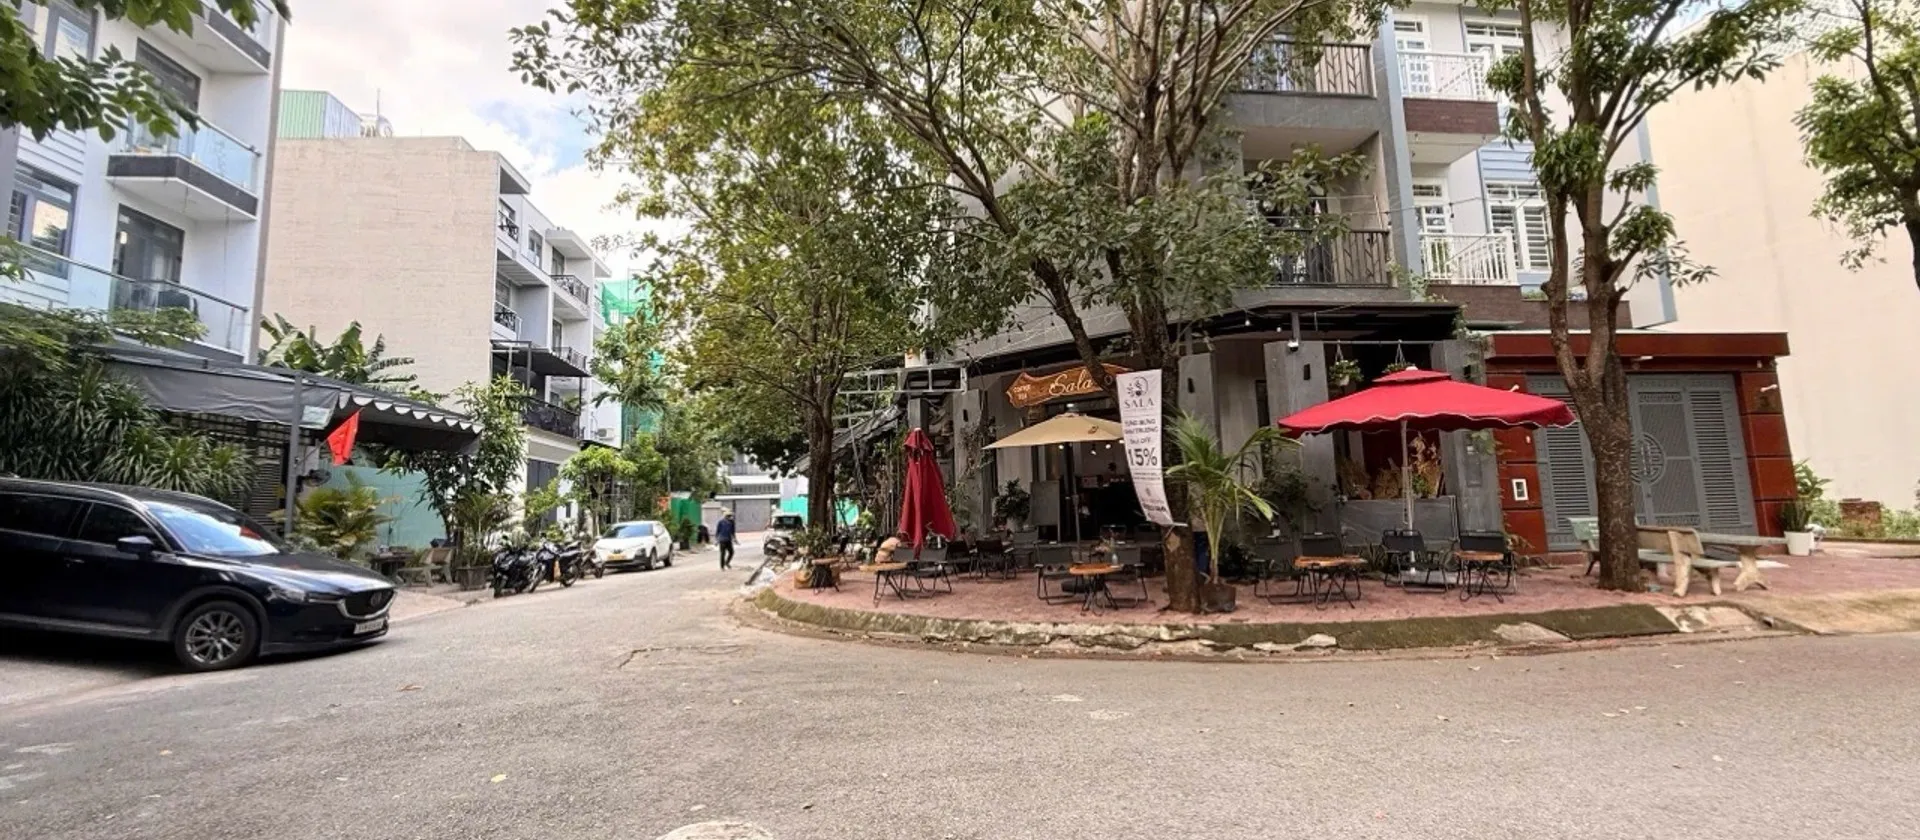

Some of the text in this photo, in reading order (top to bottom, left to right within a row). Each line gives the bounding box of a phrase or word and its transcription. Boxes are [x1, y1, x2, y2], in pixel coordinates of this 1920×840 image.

[1049, 369, 1093, 396] Sala
[1124, 397, 1154, 408] SALA
[1127, 447, 1158, 466] 15%
